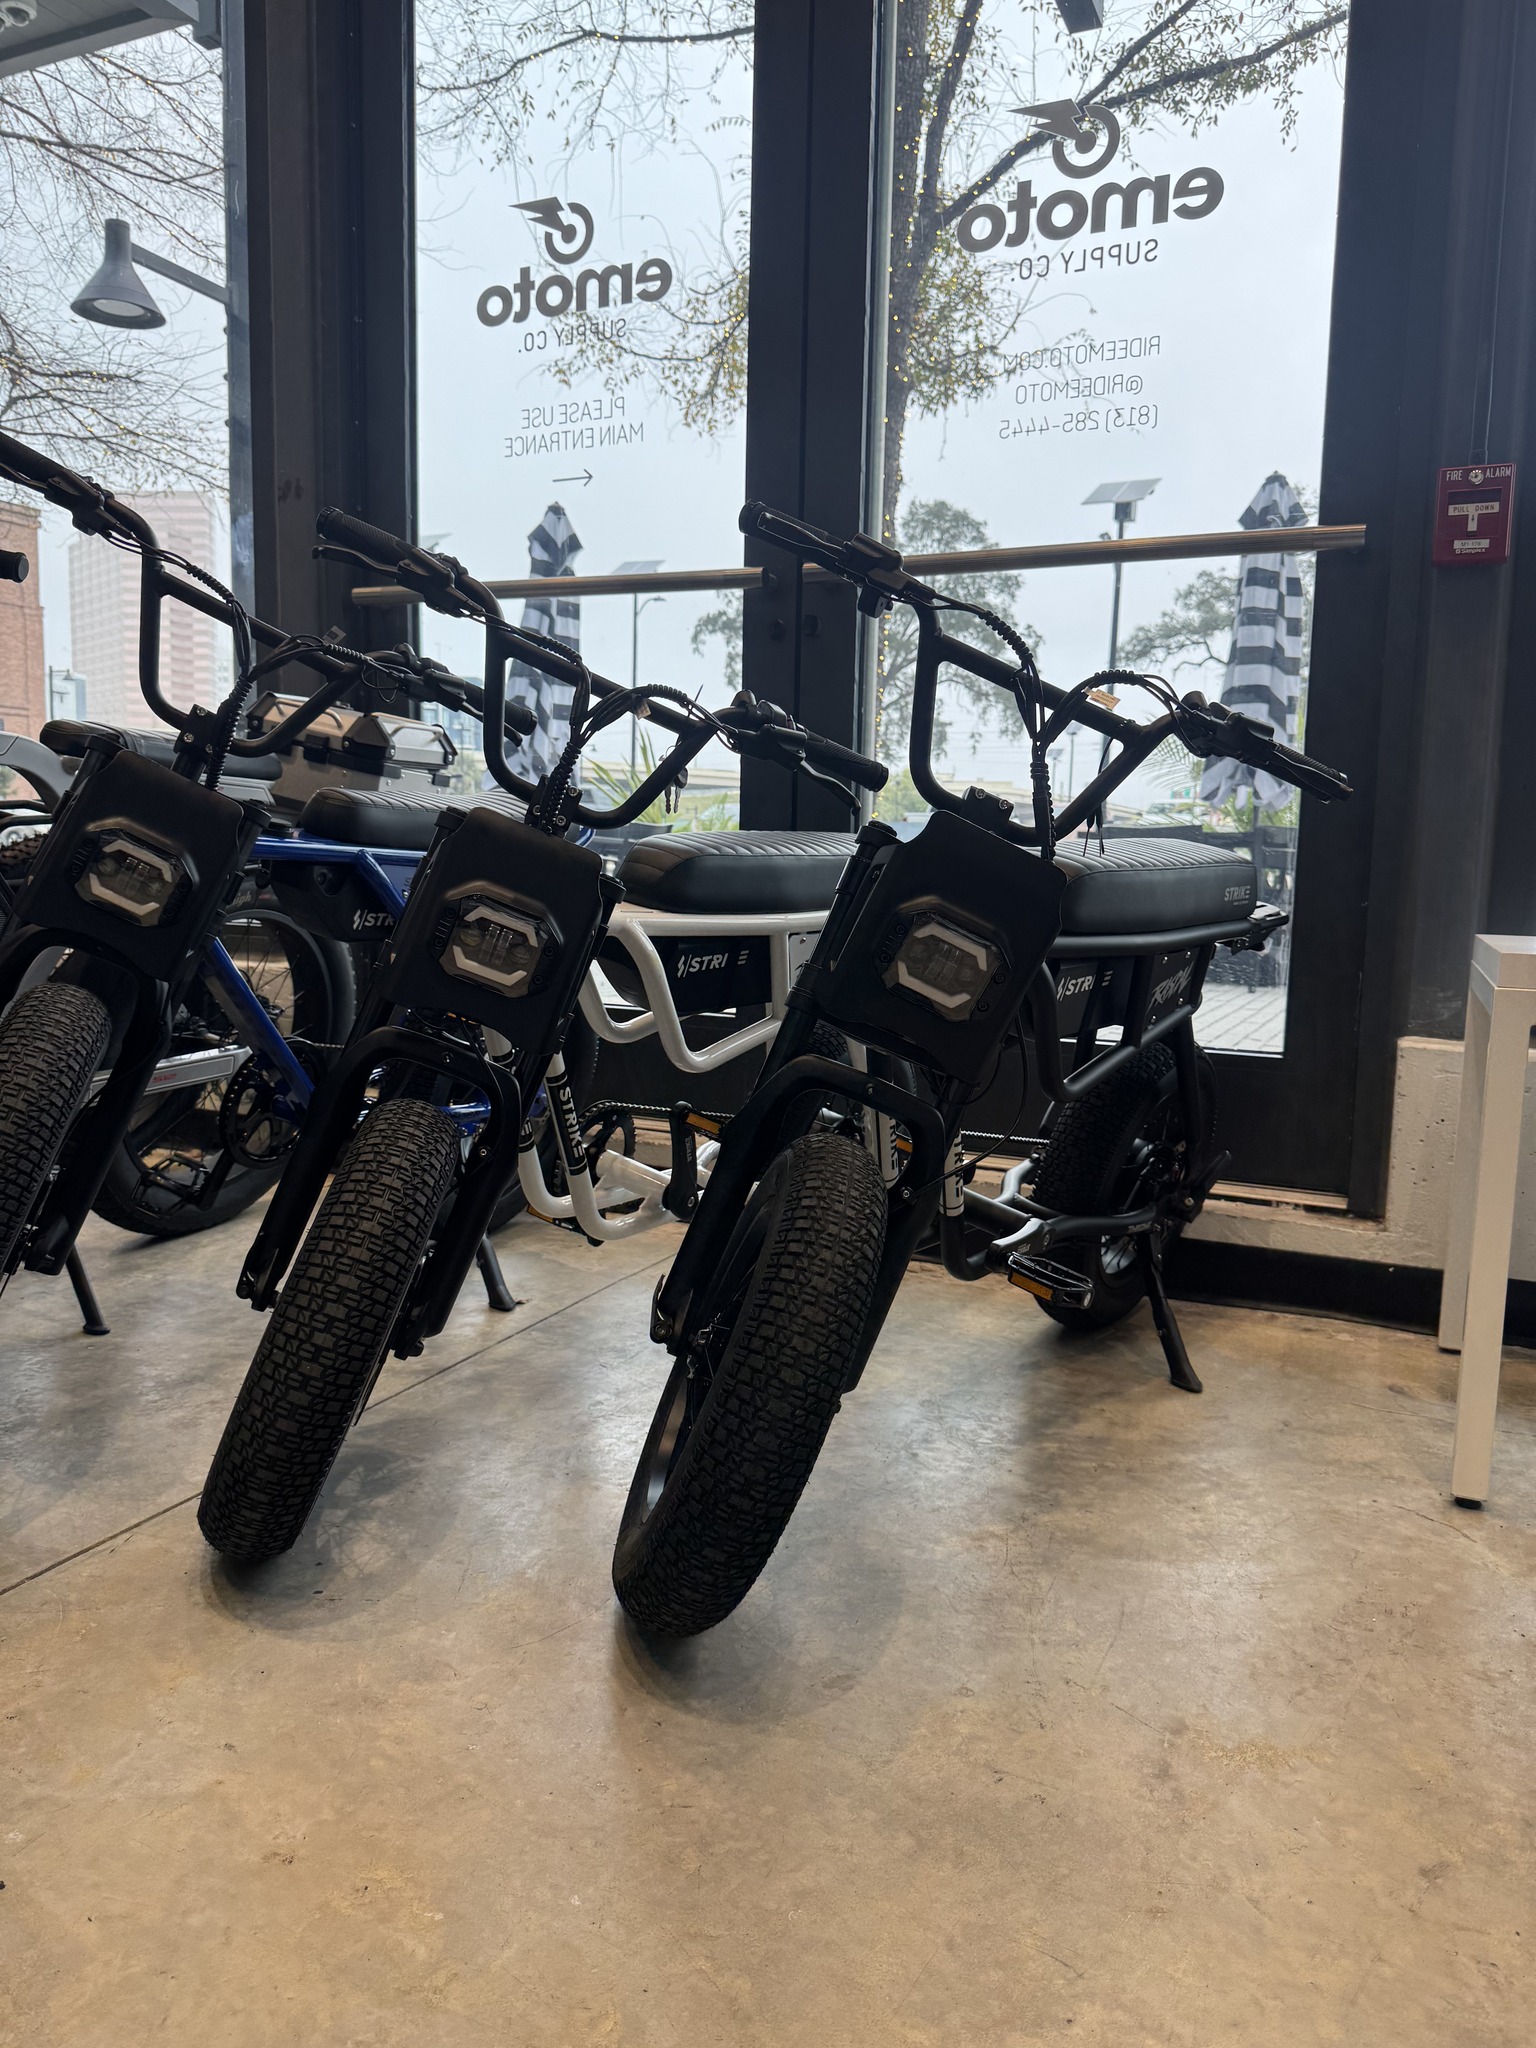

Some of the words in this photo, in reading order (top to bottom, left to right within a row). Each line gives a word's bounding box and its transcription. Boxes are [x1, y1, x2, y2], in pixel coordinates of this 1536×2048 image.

[1446, 470, 1463, 481] FIRE
[1485, 466, 1512, 478] ALARM
[1475, 504, 1494, 512] DOWN
[1224, 885, 1251, 901] STRIKE
[688, 950, 749, 973] STRIE
[1065, 970, 1113, 996] STRIE
[559, 1086, 585, 1158] STRIKE
